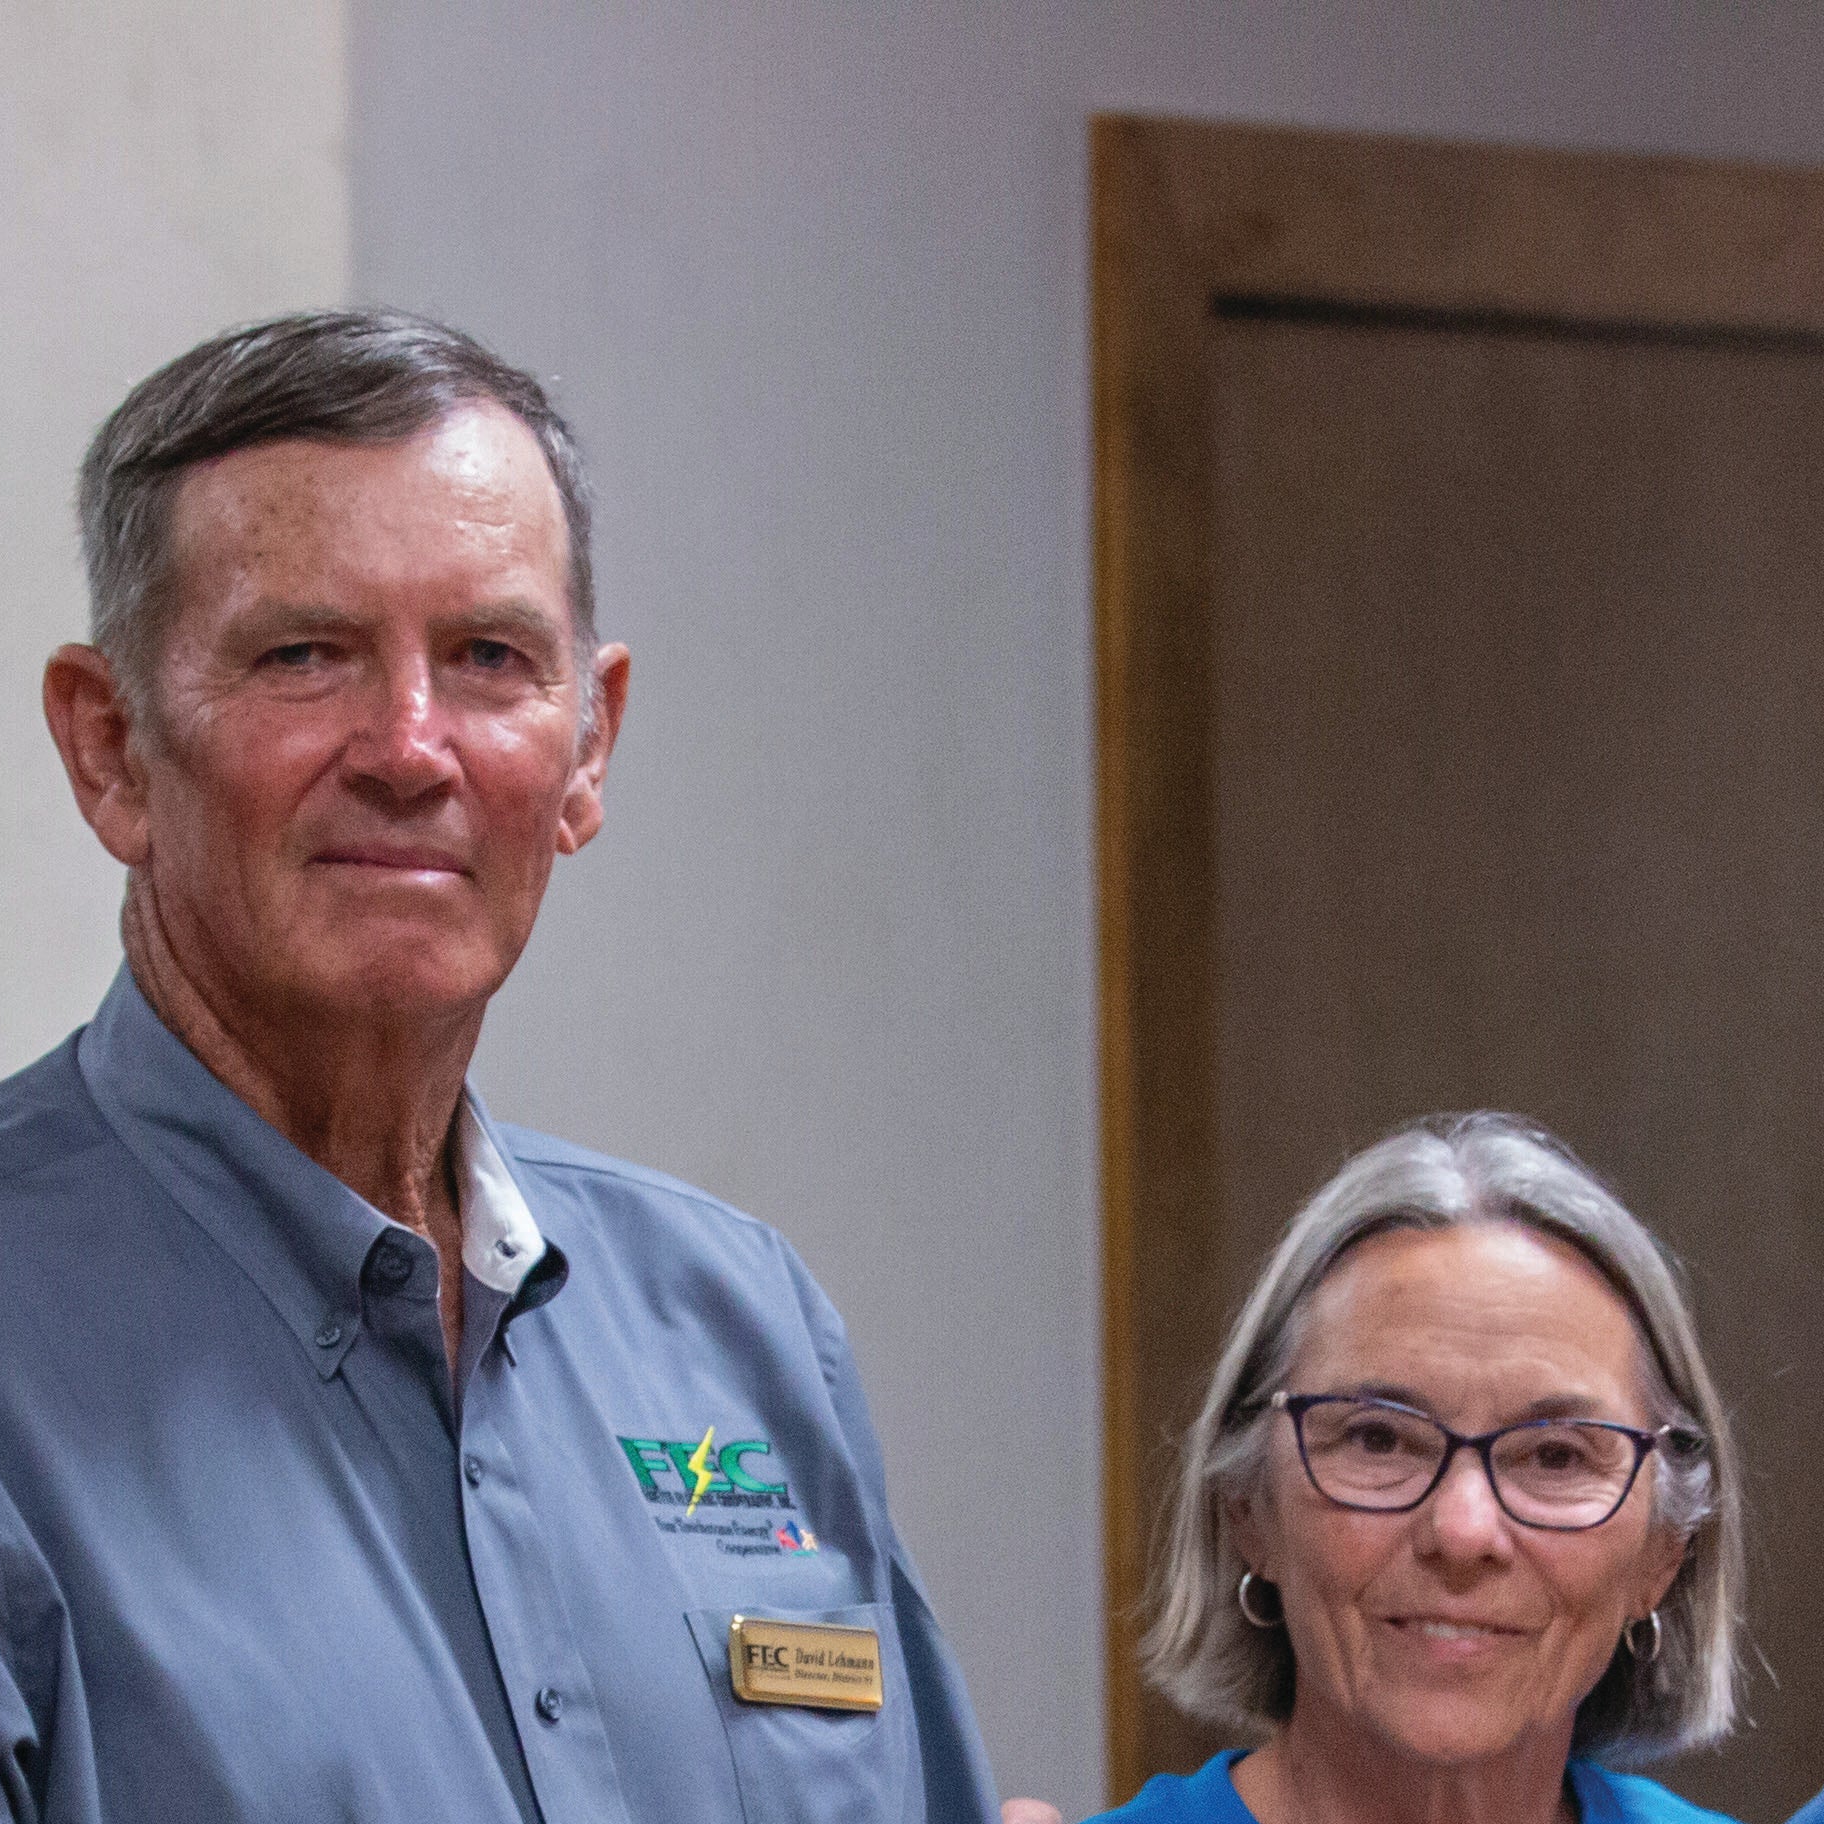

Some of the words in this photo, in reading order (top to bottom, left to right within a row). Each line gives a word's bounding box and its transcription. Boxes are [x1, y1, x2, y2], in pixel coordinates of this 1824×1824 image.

[614, 1434, 788, 1495] FEC
[745, 1644, 789, 1668] FEC
[795, 1647, 825, 1667] David
[828, 1650, 875, 1671] Lehmann
